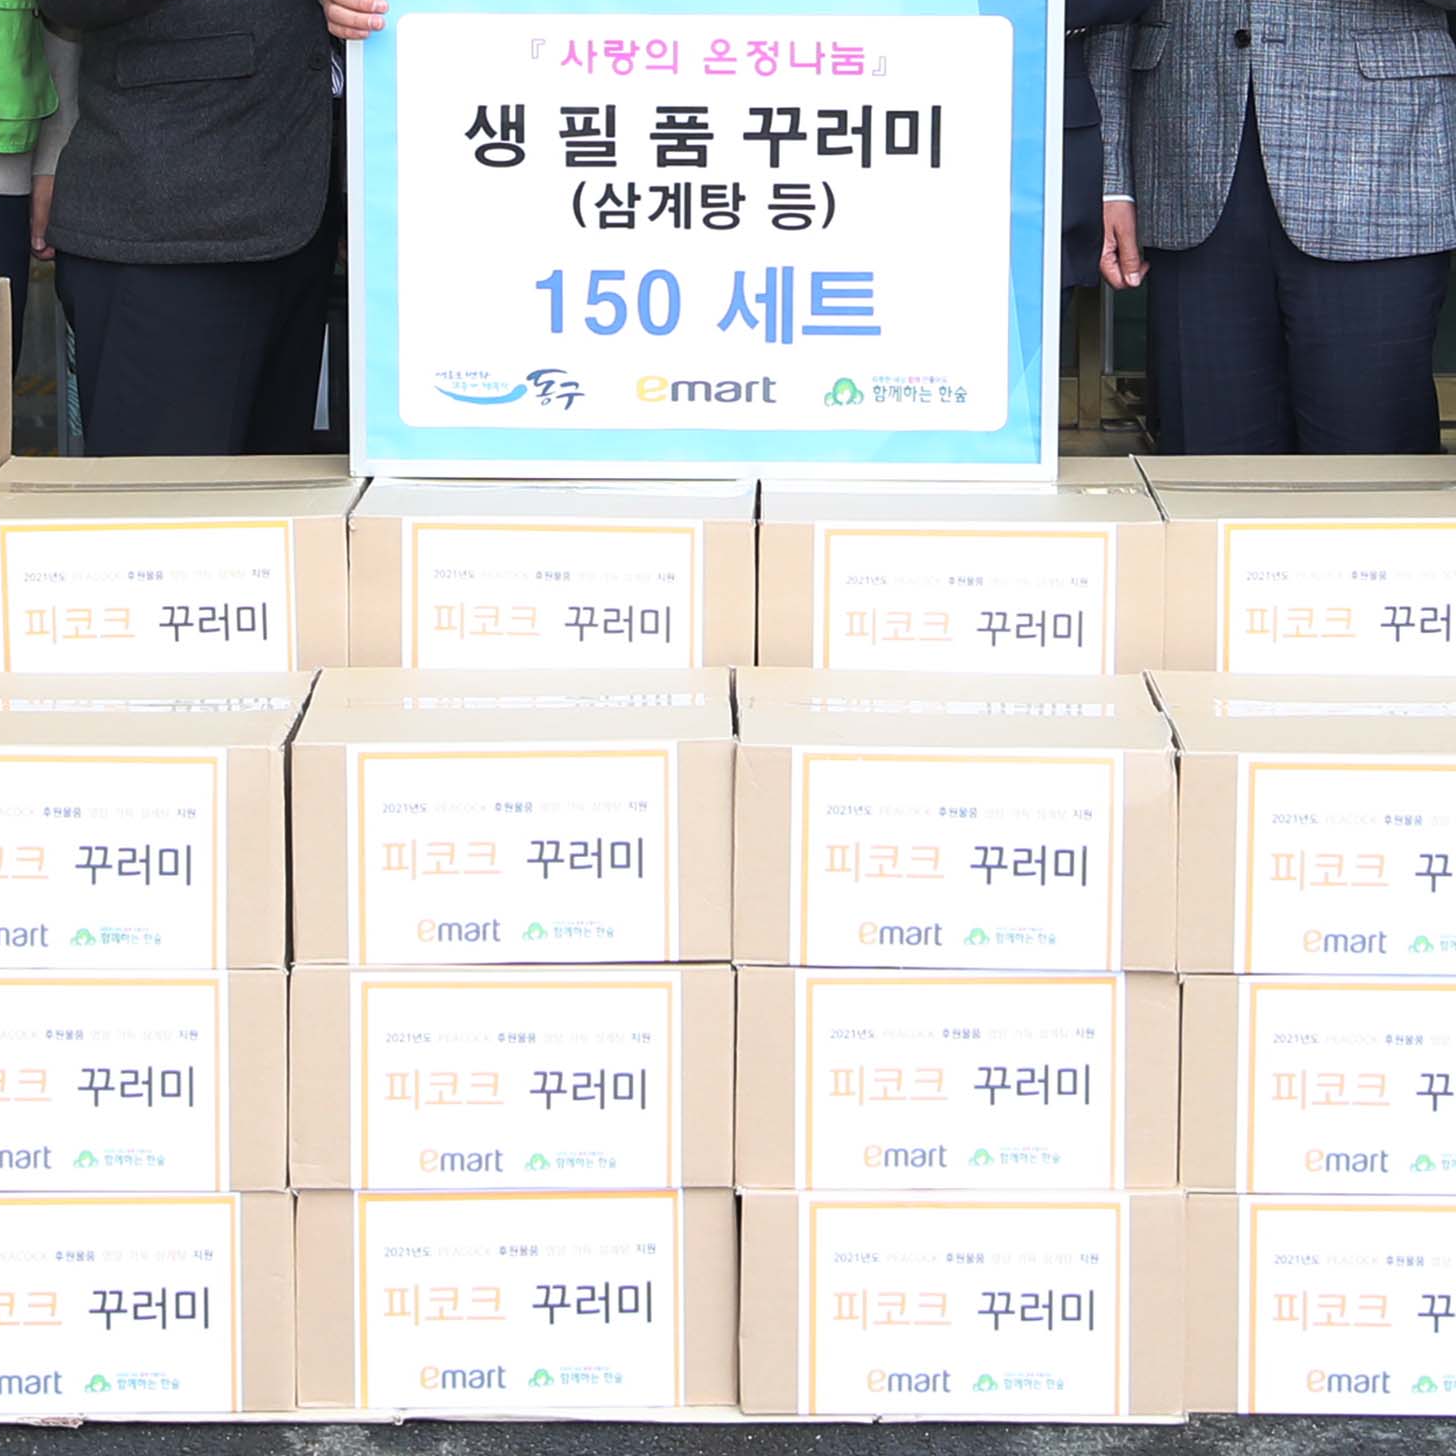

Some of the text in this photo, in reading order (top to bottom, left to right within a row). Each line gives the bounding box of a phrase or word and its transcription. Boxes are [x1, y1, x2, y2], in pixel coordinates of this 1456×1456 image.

[560, 39, 681, 76] 사랑의
[743, 105, 942, 169] 꾸러미
[571, 180, 836, 230] (삼계탕 등)
[535, 266, 881, 344] 150 세트
[526, 368, 585, 411] 동구
[637, 375, 777, 405] emart
[872, 385, 968, 403] 함께하는 한숲
[847, 609, 1083, 648] 피코크 꾸러미
[384, 837, 643, 880] 피코크 꾸러미
[416, 915, 502, 942] emart
[386, 1068, 646, 1110] 피코크 꾸러미
[418, 1146, 504, 1172] emart
[88, 1286, 209, 1331] 꾸러미
[1274, 1292, 1391, 1330] 피코크
[1306, 1367, 1392, 1394] emart
